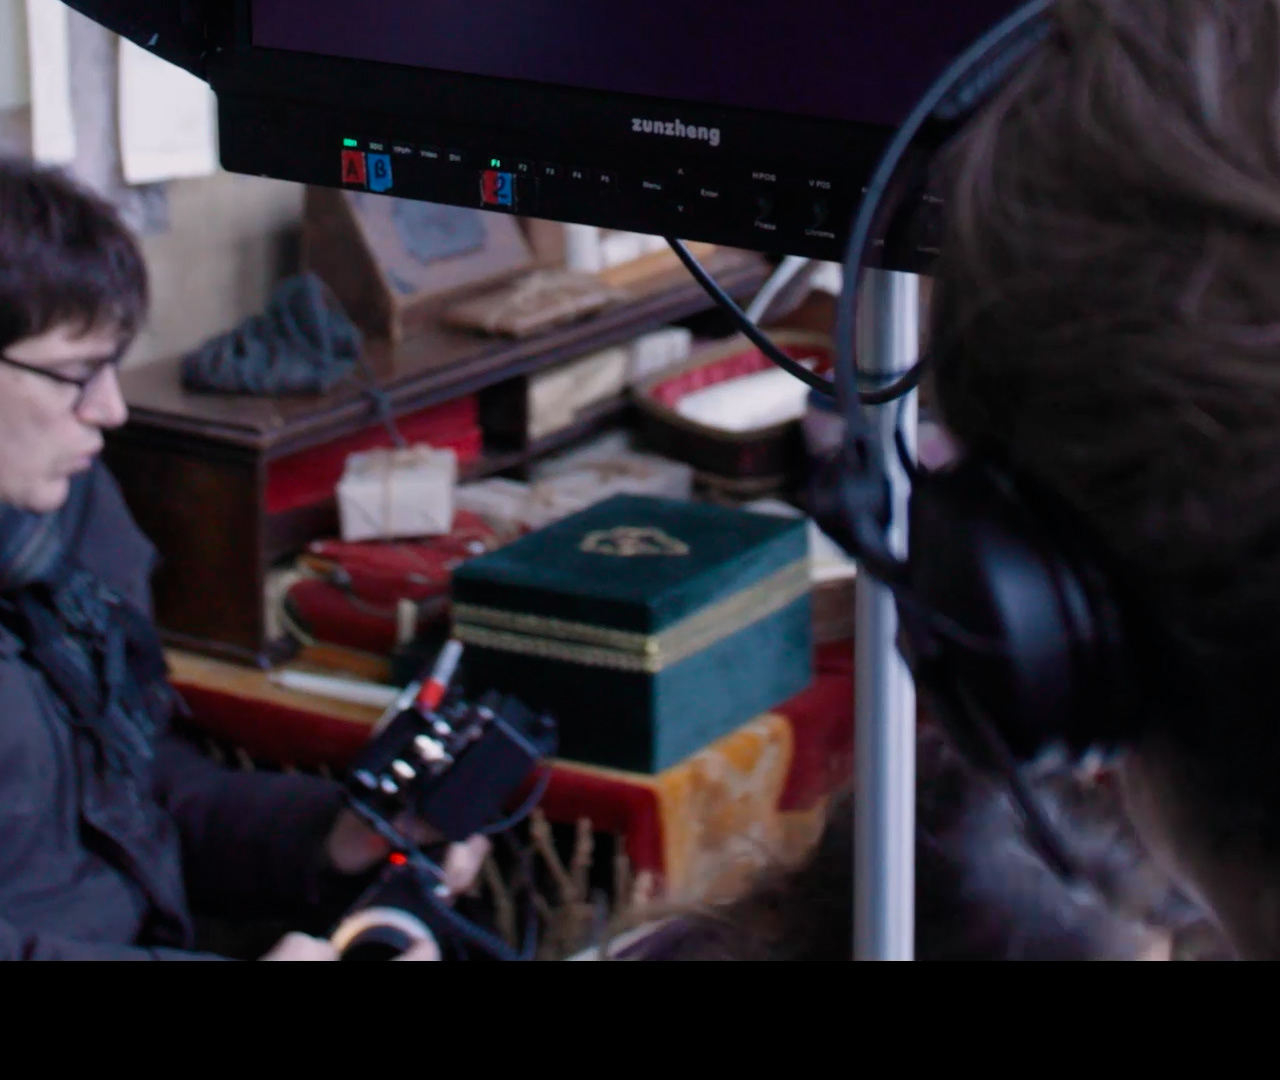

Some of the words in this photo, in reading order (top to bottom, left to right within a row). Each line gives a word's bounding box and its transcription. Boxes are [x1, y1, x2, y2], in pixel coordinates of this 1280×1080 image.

[631, 118, 721, 147] zunzheng
[346, 158, 359, 180] A
[374, 158, 387, 180] B
[493, 175, 509, 199] 2
